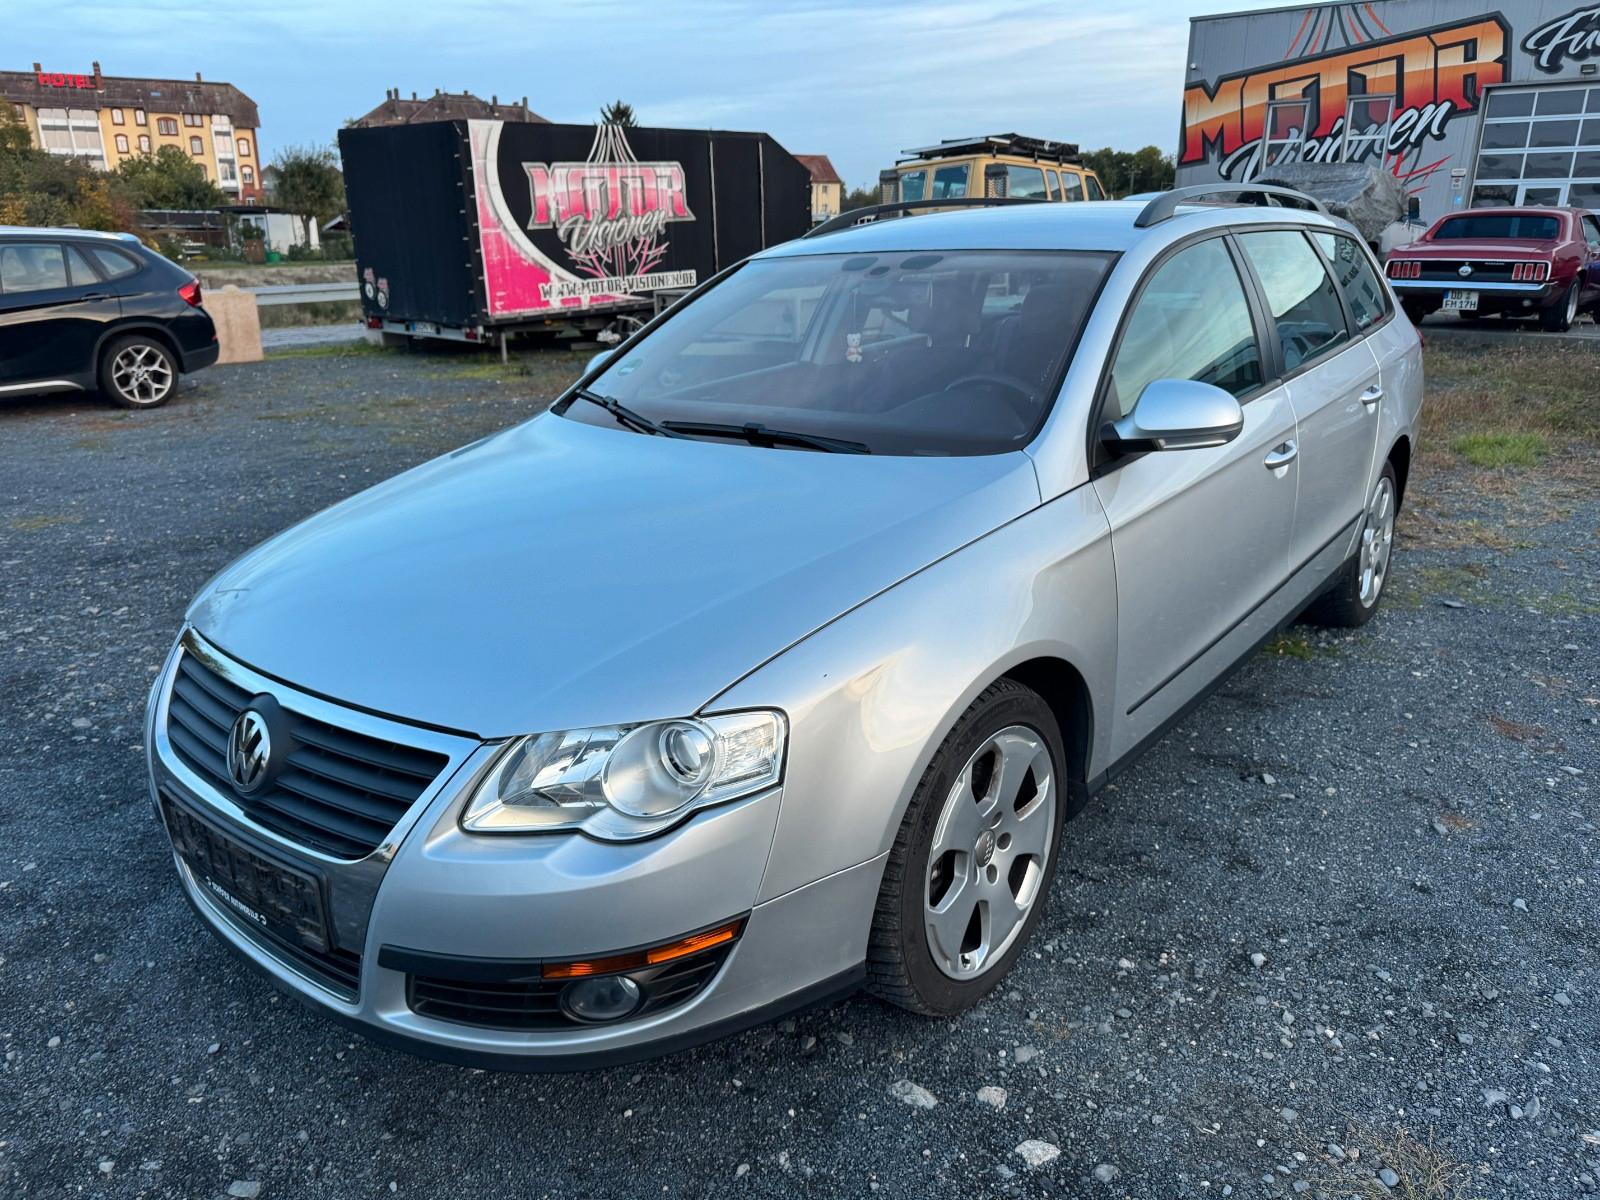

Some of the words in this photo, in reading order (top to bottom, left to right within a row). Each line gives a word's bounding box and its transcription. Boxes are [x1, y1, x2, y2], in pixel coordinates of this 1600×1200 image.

[38, 71, 96, 89] HOTEL
[1181, 14, 1511, 164] MOTOR
[523, 162, 695, 229] MOTOR
[558, 209, 666, 253] Visionen
